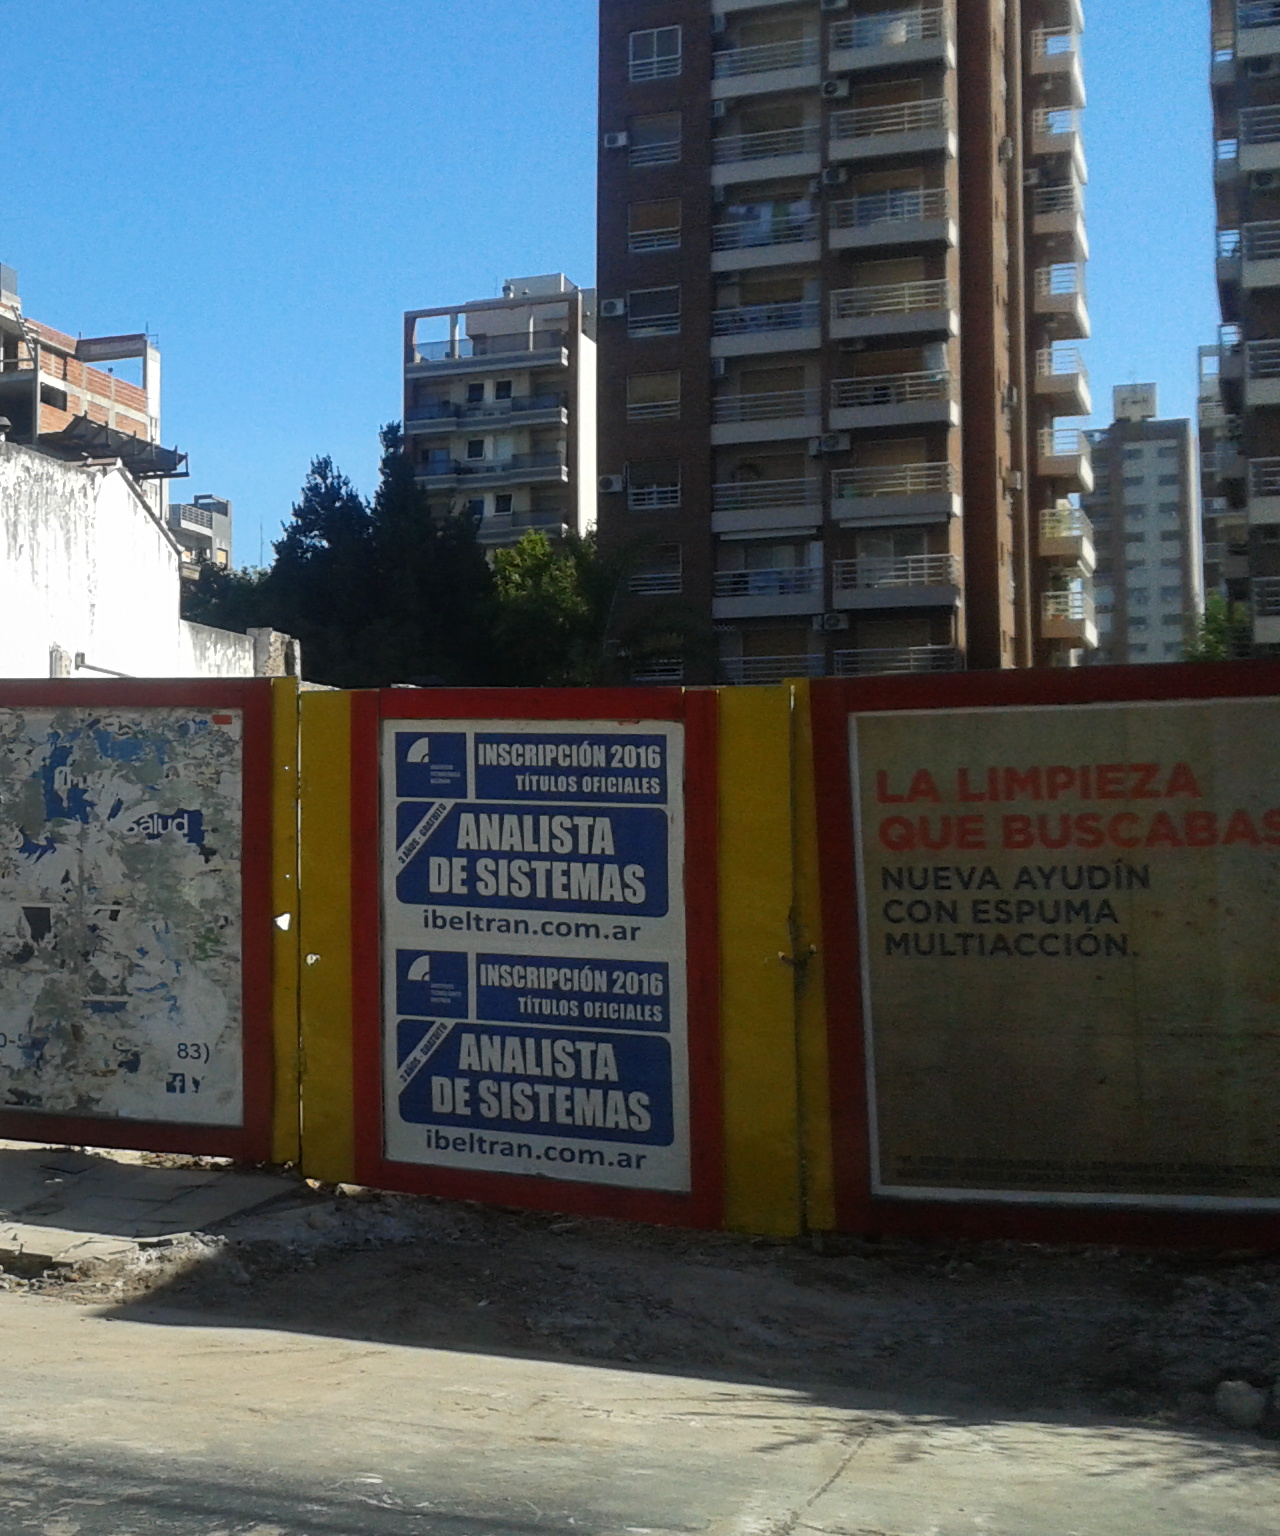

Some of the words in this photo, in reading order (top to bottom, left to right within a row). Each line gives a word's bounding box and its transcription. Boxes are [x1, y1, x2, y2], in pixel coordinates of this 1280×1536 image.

[478, 741, 606, 768] INSCRIPCIÓN
[611, 745, 661, 769] 2016
[516, 773, 577, 792] TÍTULOS
[582, 776, 660, 795] OFICIALES
[876, 769, 940, 804] LA
[958, 762, 1202, 802] LIMPIEZA
[457, 813, 615, 855] ANALISTA
[878, 814, 986, 851] QUE
[429, 856, 468, 895] DE
[476, 857, 646, 904] SISTEMAS
[882, 866, 1000, 891] NUEVA
[1013, 858, 1150, 890] AYUDÍN
[423, 909, 641, 942] ibeltran.com.ar
[883, 900, 958, 925] CON
[972, 899, 1118, 925] ESPUMA
[480, 964, 608, 994] INSCRIPCIÓN
[612, 970, 664, 996] 2016
[518, 995, 579, 1017] TÍTULOS
[583, 1001, 663, 1022] OFICIALES
[458, 1032, 618, 1082] ANALISTA
[431, 1075, 471, 1115] DE
[478, 1079, 651, 1132] SISTEMAS
[426, 1129, 646, 1170] ibeltran.com.ar
